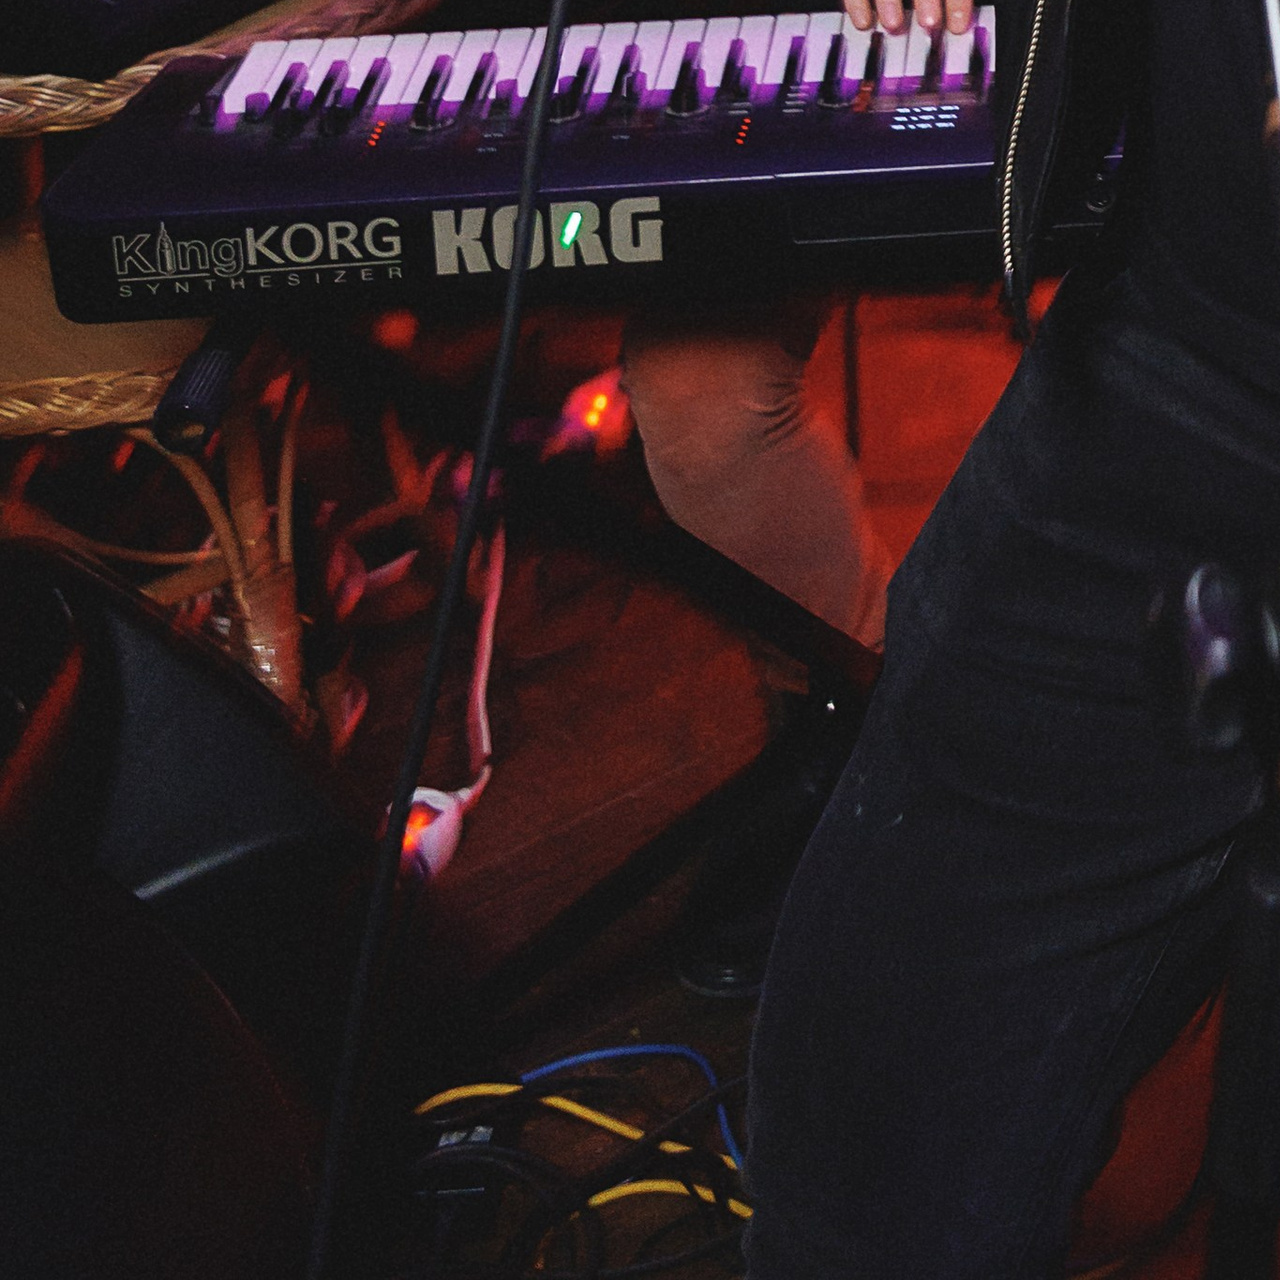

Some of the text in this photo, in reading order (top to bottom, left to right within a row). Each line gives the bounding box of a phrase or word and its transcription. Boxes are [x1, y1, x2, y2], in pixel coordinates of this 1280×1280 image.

[114, 218, 402, 277] KingKORG
[431, 196, 665, 276] KORG
[118, 265, 402, 298] SYNTHESIZER
